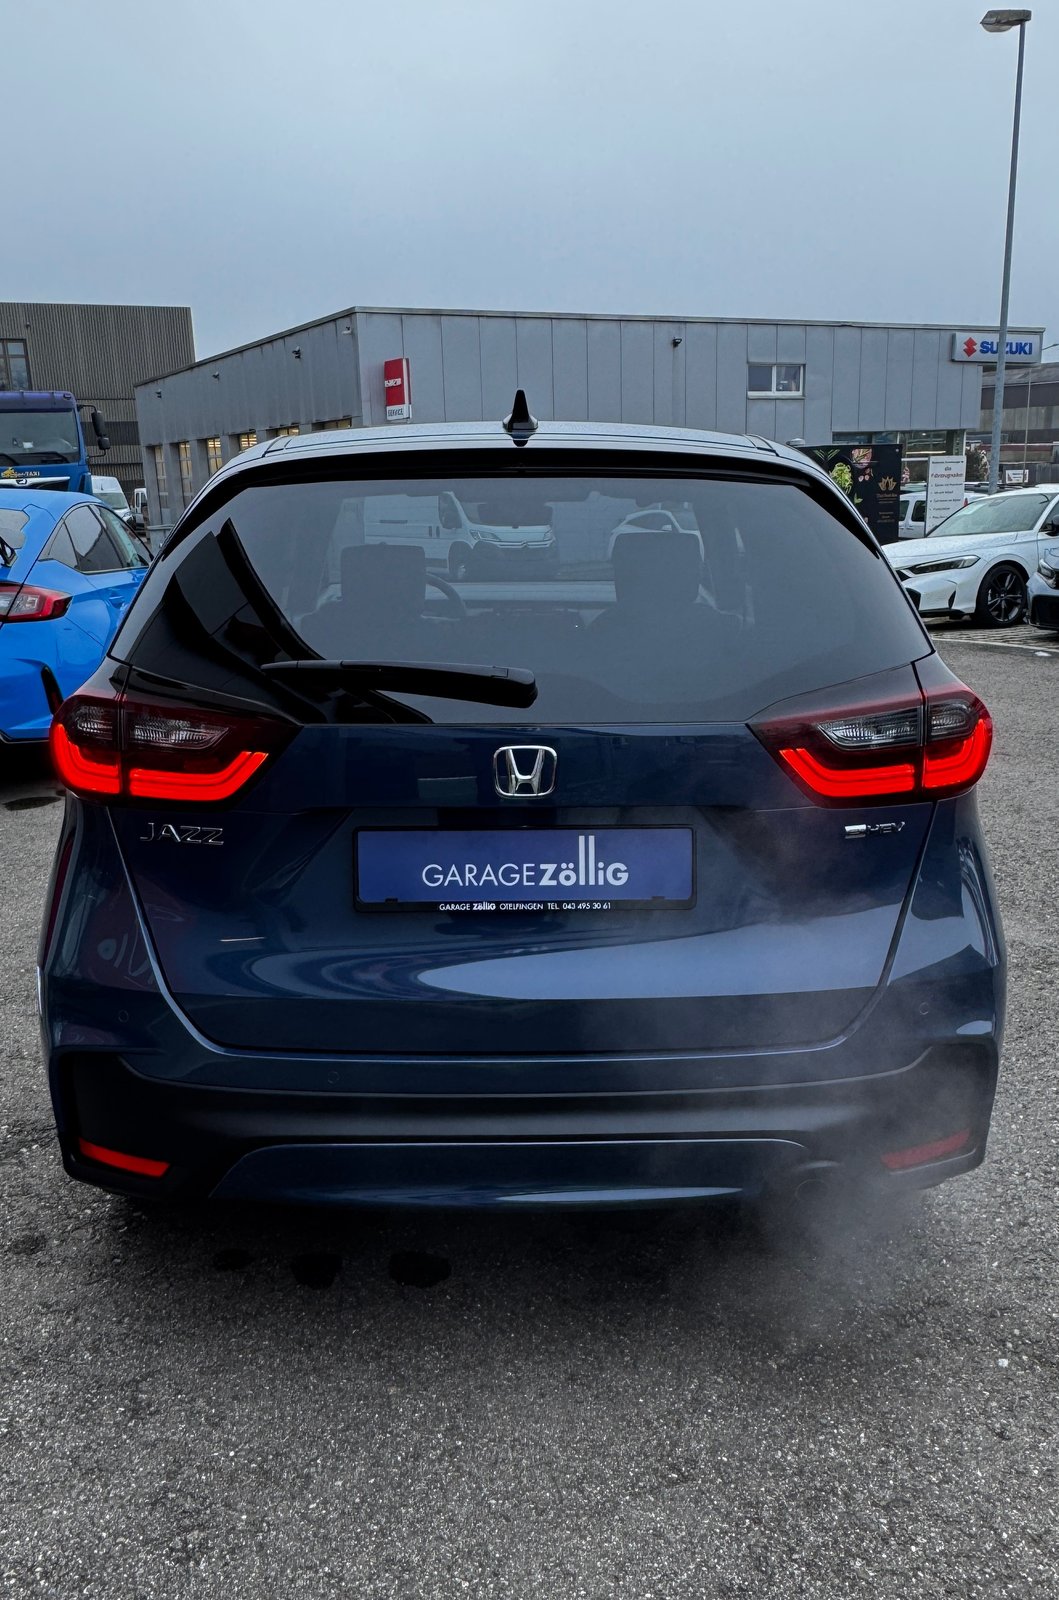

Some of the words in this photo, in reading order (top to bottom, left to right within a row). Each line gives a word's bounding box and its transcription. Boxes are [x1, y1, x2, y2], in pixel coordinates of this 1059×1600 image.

[980, 340, 1033, 355] SUUKI
[140, 822, 225, 846] JAZZ
[439, 903, 471, 911] GARAGE
[499, 902, 544, 911] OTELFINGEN
[562, 902, 576, 910] 043
[577, 902, 591, 910] 495
[592, 902, 602, 910] 30
[603, 902, 611, 910] 61
